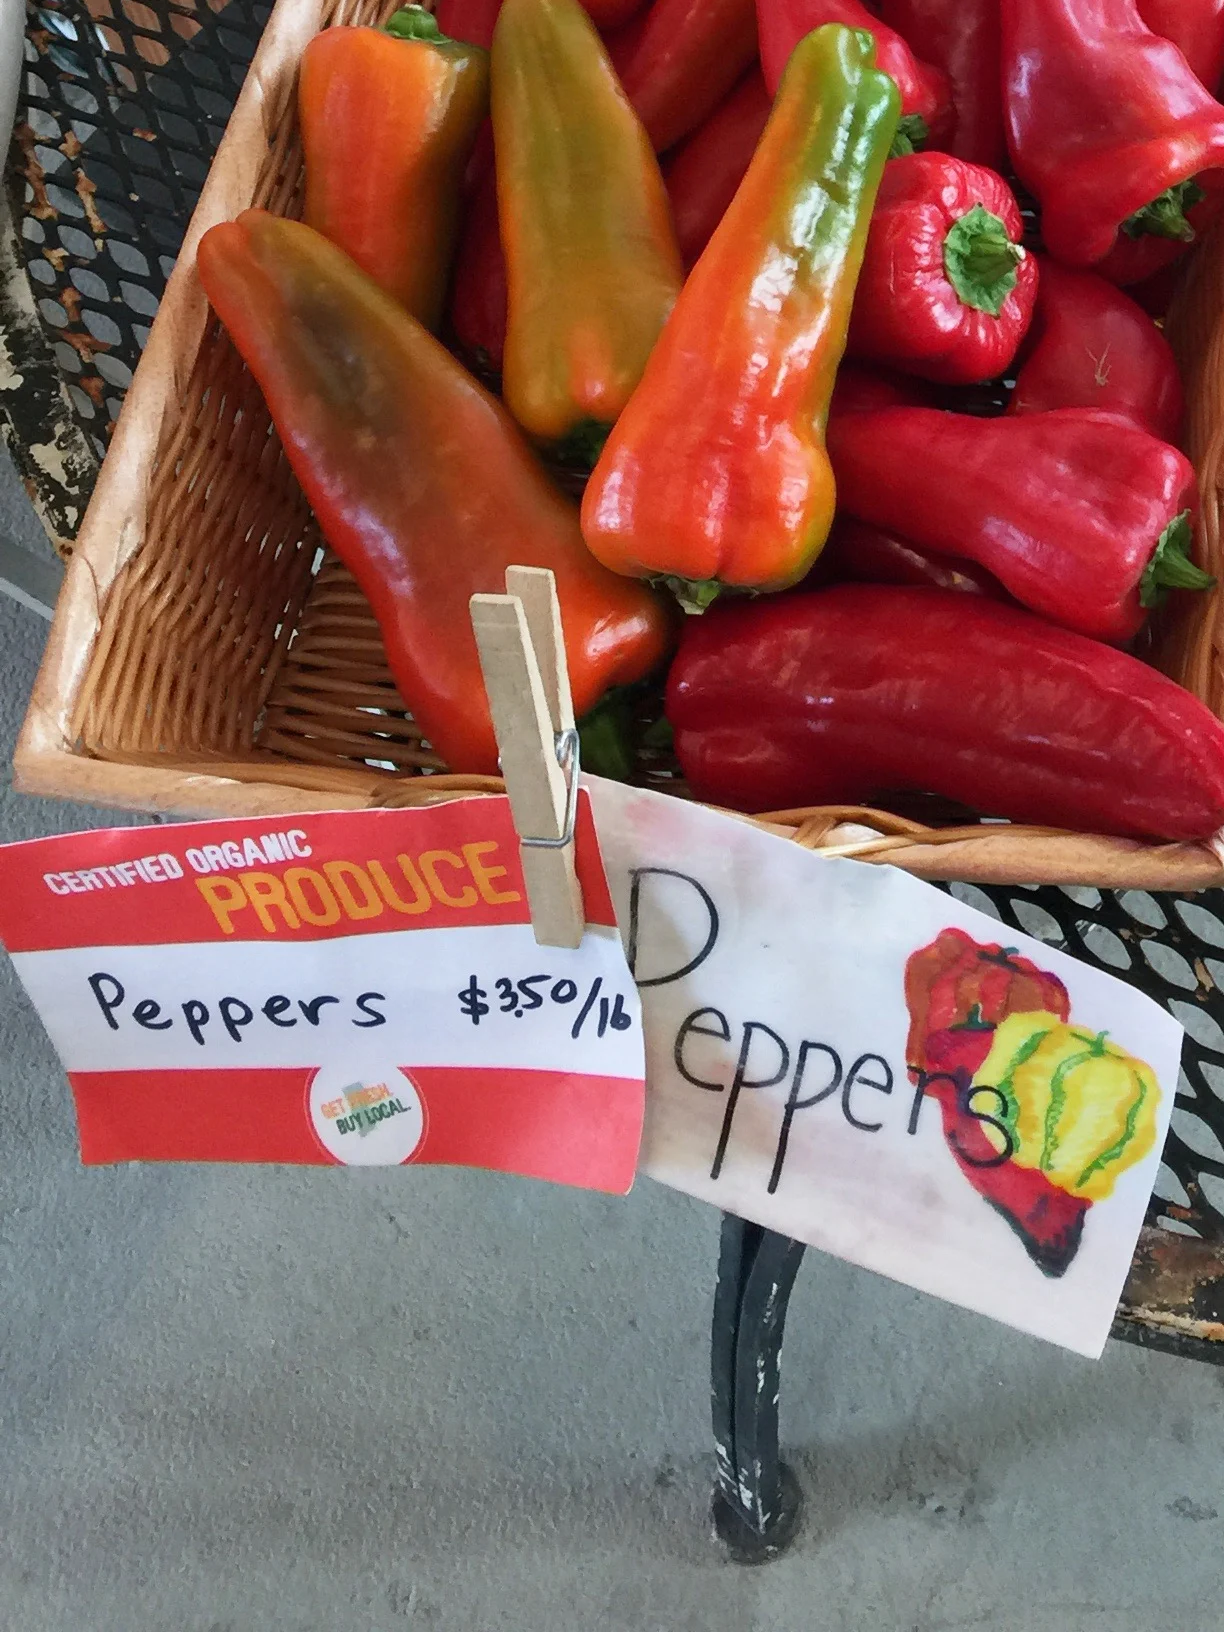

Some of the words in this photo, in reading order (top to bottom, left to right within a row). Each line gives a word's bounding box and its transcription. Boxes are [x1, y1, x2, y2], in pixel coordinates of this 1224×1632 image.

[43, 852, 185, 897] CERTIFIED
[186, 829, 313, 874] ORGANIC
[198, 841, 521, 934] PRODUCE
[88, 972, 387, 1046] Peppers
[336, 1111, 363, 1135] BUY
